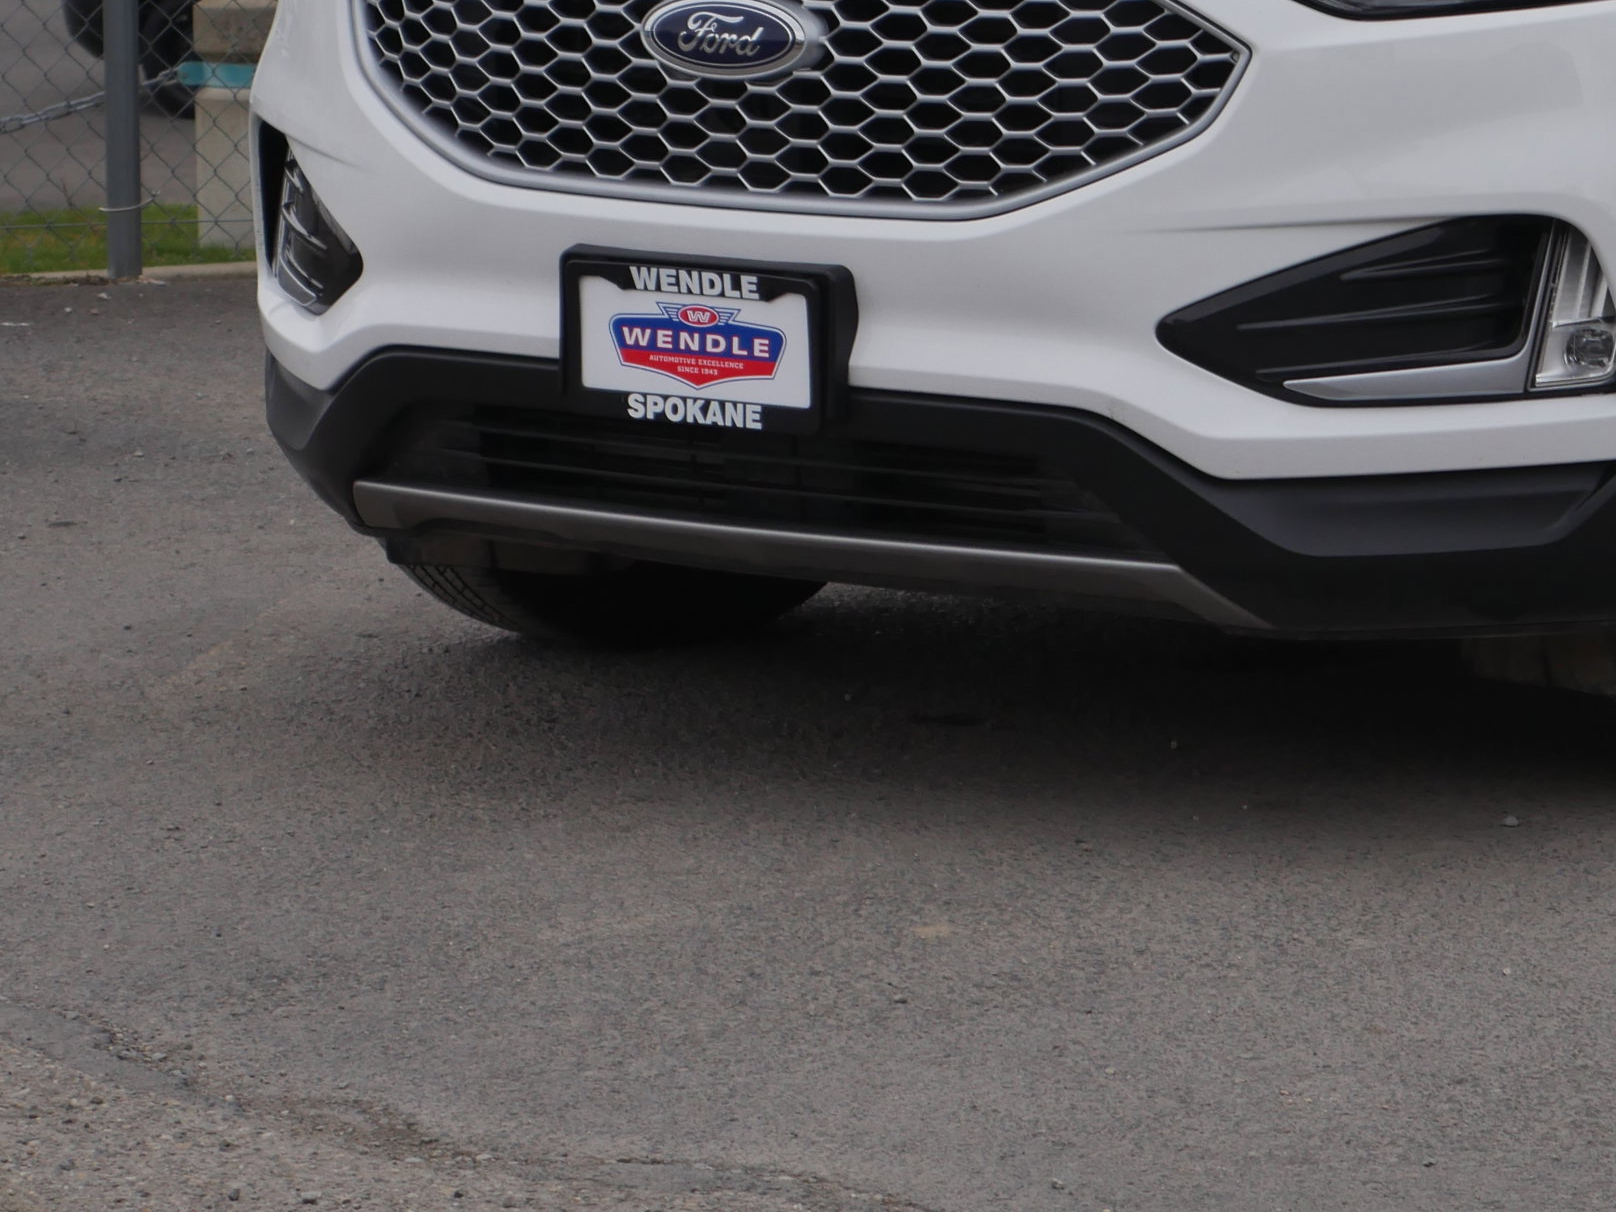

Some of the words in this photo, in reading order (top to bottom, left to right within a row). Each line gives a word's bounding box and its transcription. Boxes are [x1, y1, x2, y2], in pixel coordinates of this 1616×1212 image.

[677, 11, 764, 56] Ford
[629, 266, 760, 300] WENDLE
[622, 326, 770, 358] WENDLE
[649, 354, 696, 365] AUTOMOTIVE
[698, 359, 744, 370] EXCELLENCE
[677, 365, 699, 374] SINCE
[701, 368, 718, 376] 1943
[627, 392, 763, 430] SPOKANE
